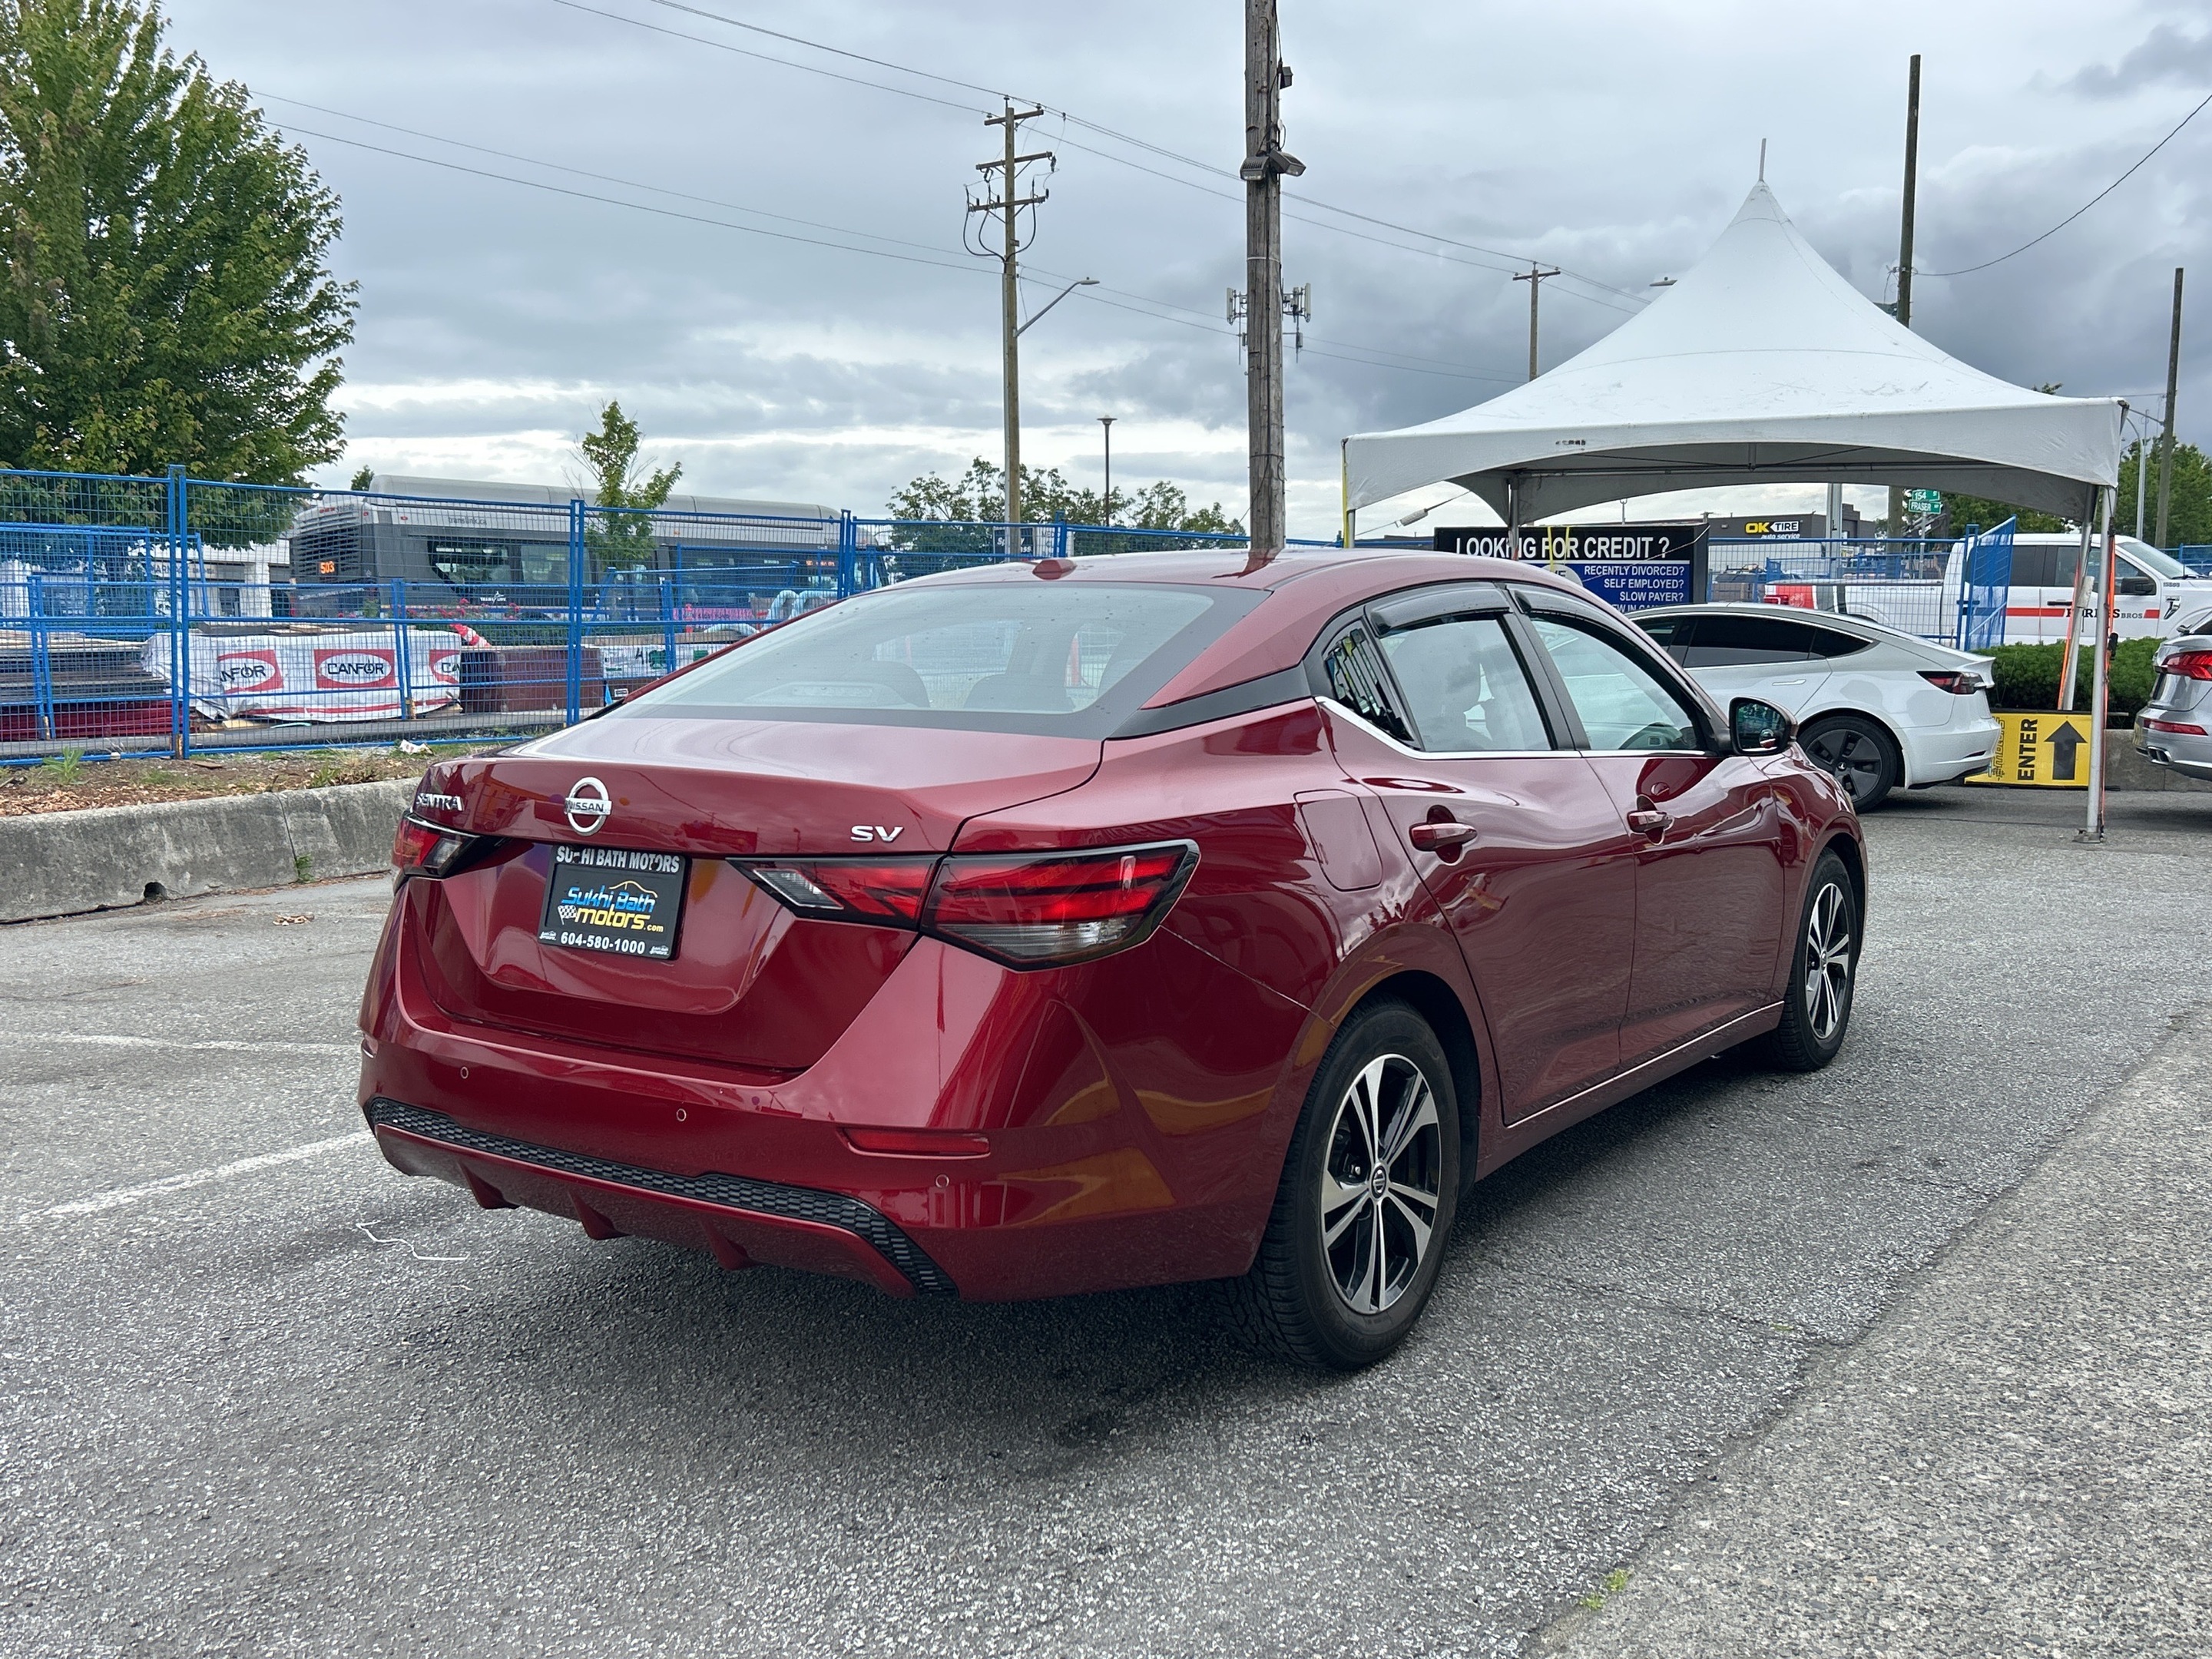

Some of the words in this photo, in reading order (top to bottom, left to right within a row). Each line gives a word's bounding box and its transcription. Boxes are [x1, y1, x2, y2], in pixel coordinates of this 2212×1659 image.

[1914, 492, 1926, 500] 154
[1911, 502, 1932, 512] FRASER
[1746, 522, 1770, 534] OK
[1541, 537, 1579, 558] FOR
[1584, 537, 1653, 558] CREDIT
[320, 561, 335, 575] 503
[1584, 565, 1629, 575] RECENTLY
[1631, 566, 1684, 576] DIVORCED?
[1604, 578, 1626, 588] SELF
[1628, 578, 1684, 589] EMPLOYED?
[1619, 591, 1646, 601] SLOW
[1648, 592, 1684, 602] PAYER?
[327, 661, 384, 674] CANFOR
[2017, 719, 2038, 780] ENTER
[416, 793, 464, 811] SENTRA
[565, 799, 605, 813] NISSAN
[850, 825, 903, 842] SV
[596, 849, 626, 868] BATH
[561, 886, 614, 908] Sukhi
[615, 890, 656, 912] Bath
[560, 932, 645, 955] 604-580-1000
